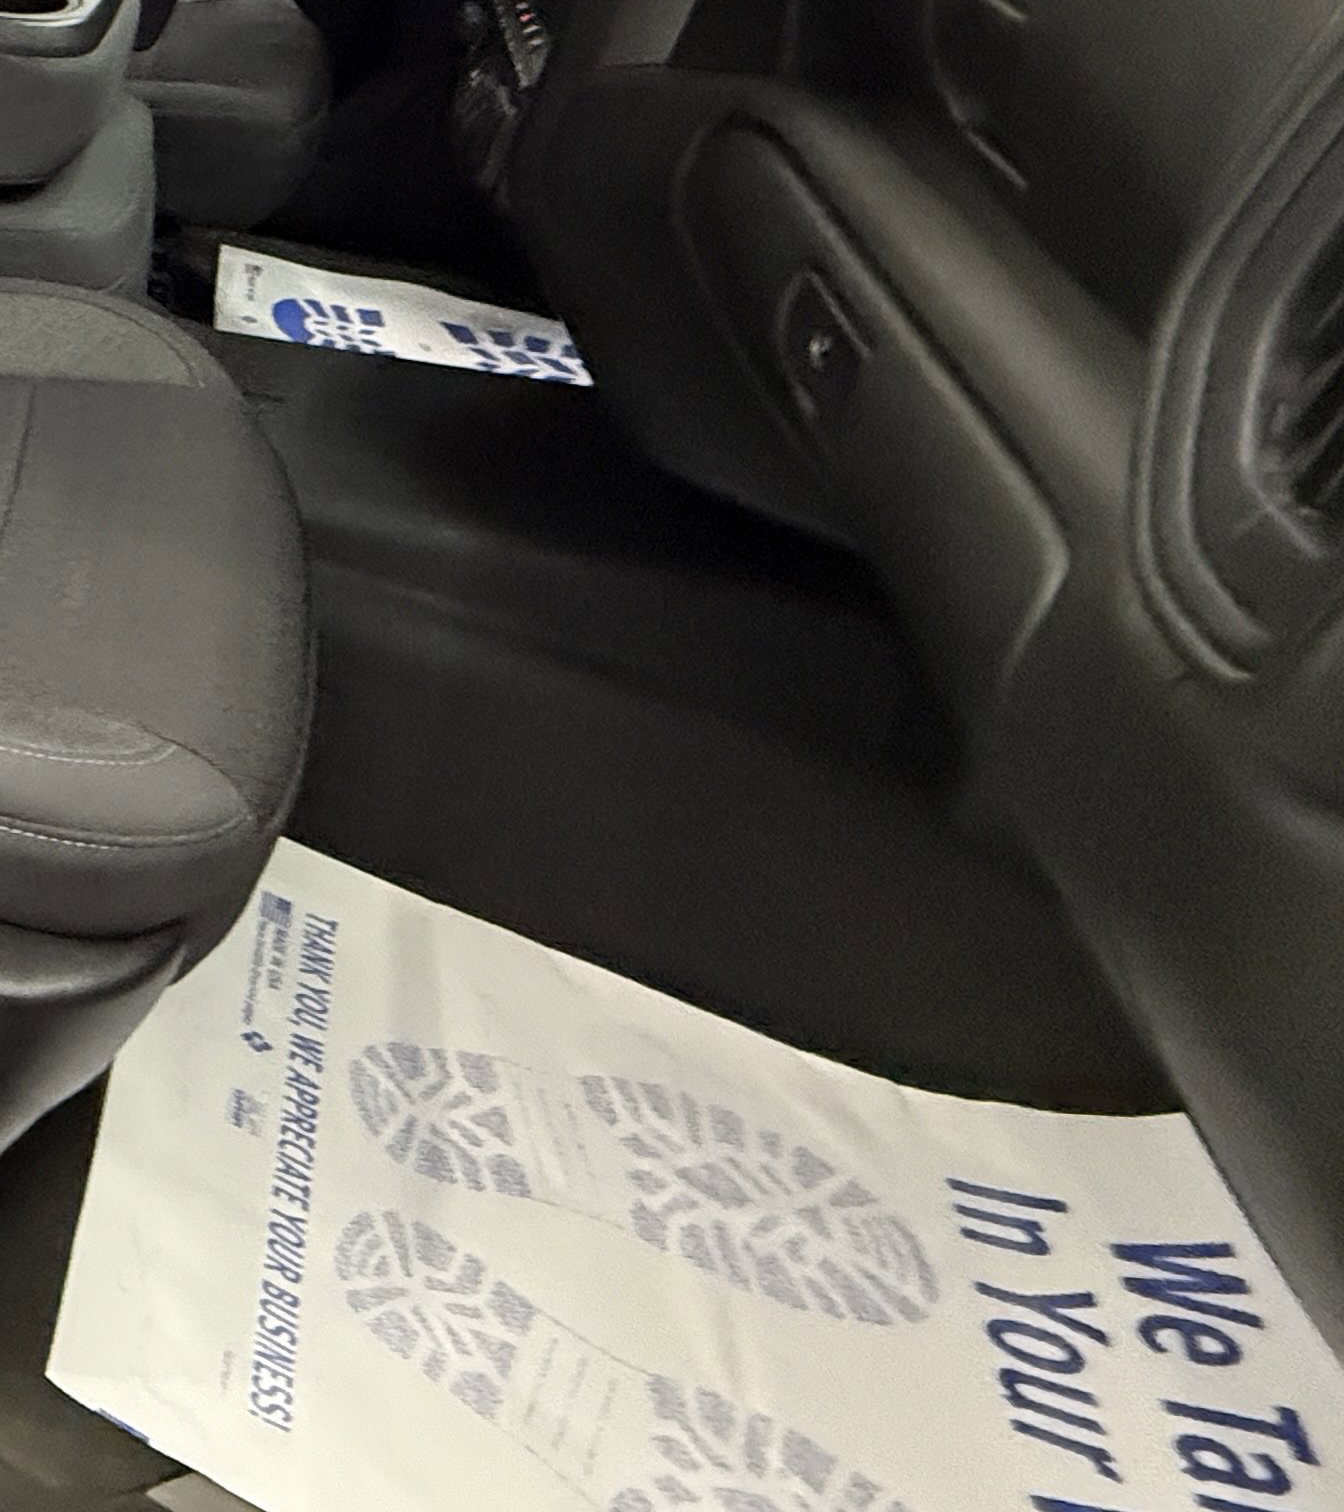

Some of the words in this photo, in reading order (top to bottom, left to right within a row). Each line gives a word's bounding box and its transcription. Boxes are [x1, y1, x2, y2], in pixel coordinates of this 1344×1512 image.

[297, 912, 339, 985] THANK
[286, 981, 332, 1031] YOU,
[288, 1032, 325, 1074] WE
[270, 1066, 322, 1212] APPRECIATE
[262, 1207, 309, 1285] YOUR
[945, 1176, 1069, 1257] In
[1109, 1241, 1265, 1367] We
[247, 1278, 302, 1433] BUSINESS!
[973, 1281, 1124, 1484] Your
[1160, 1398, 1321, 1512] Ta
